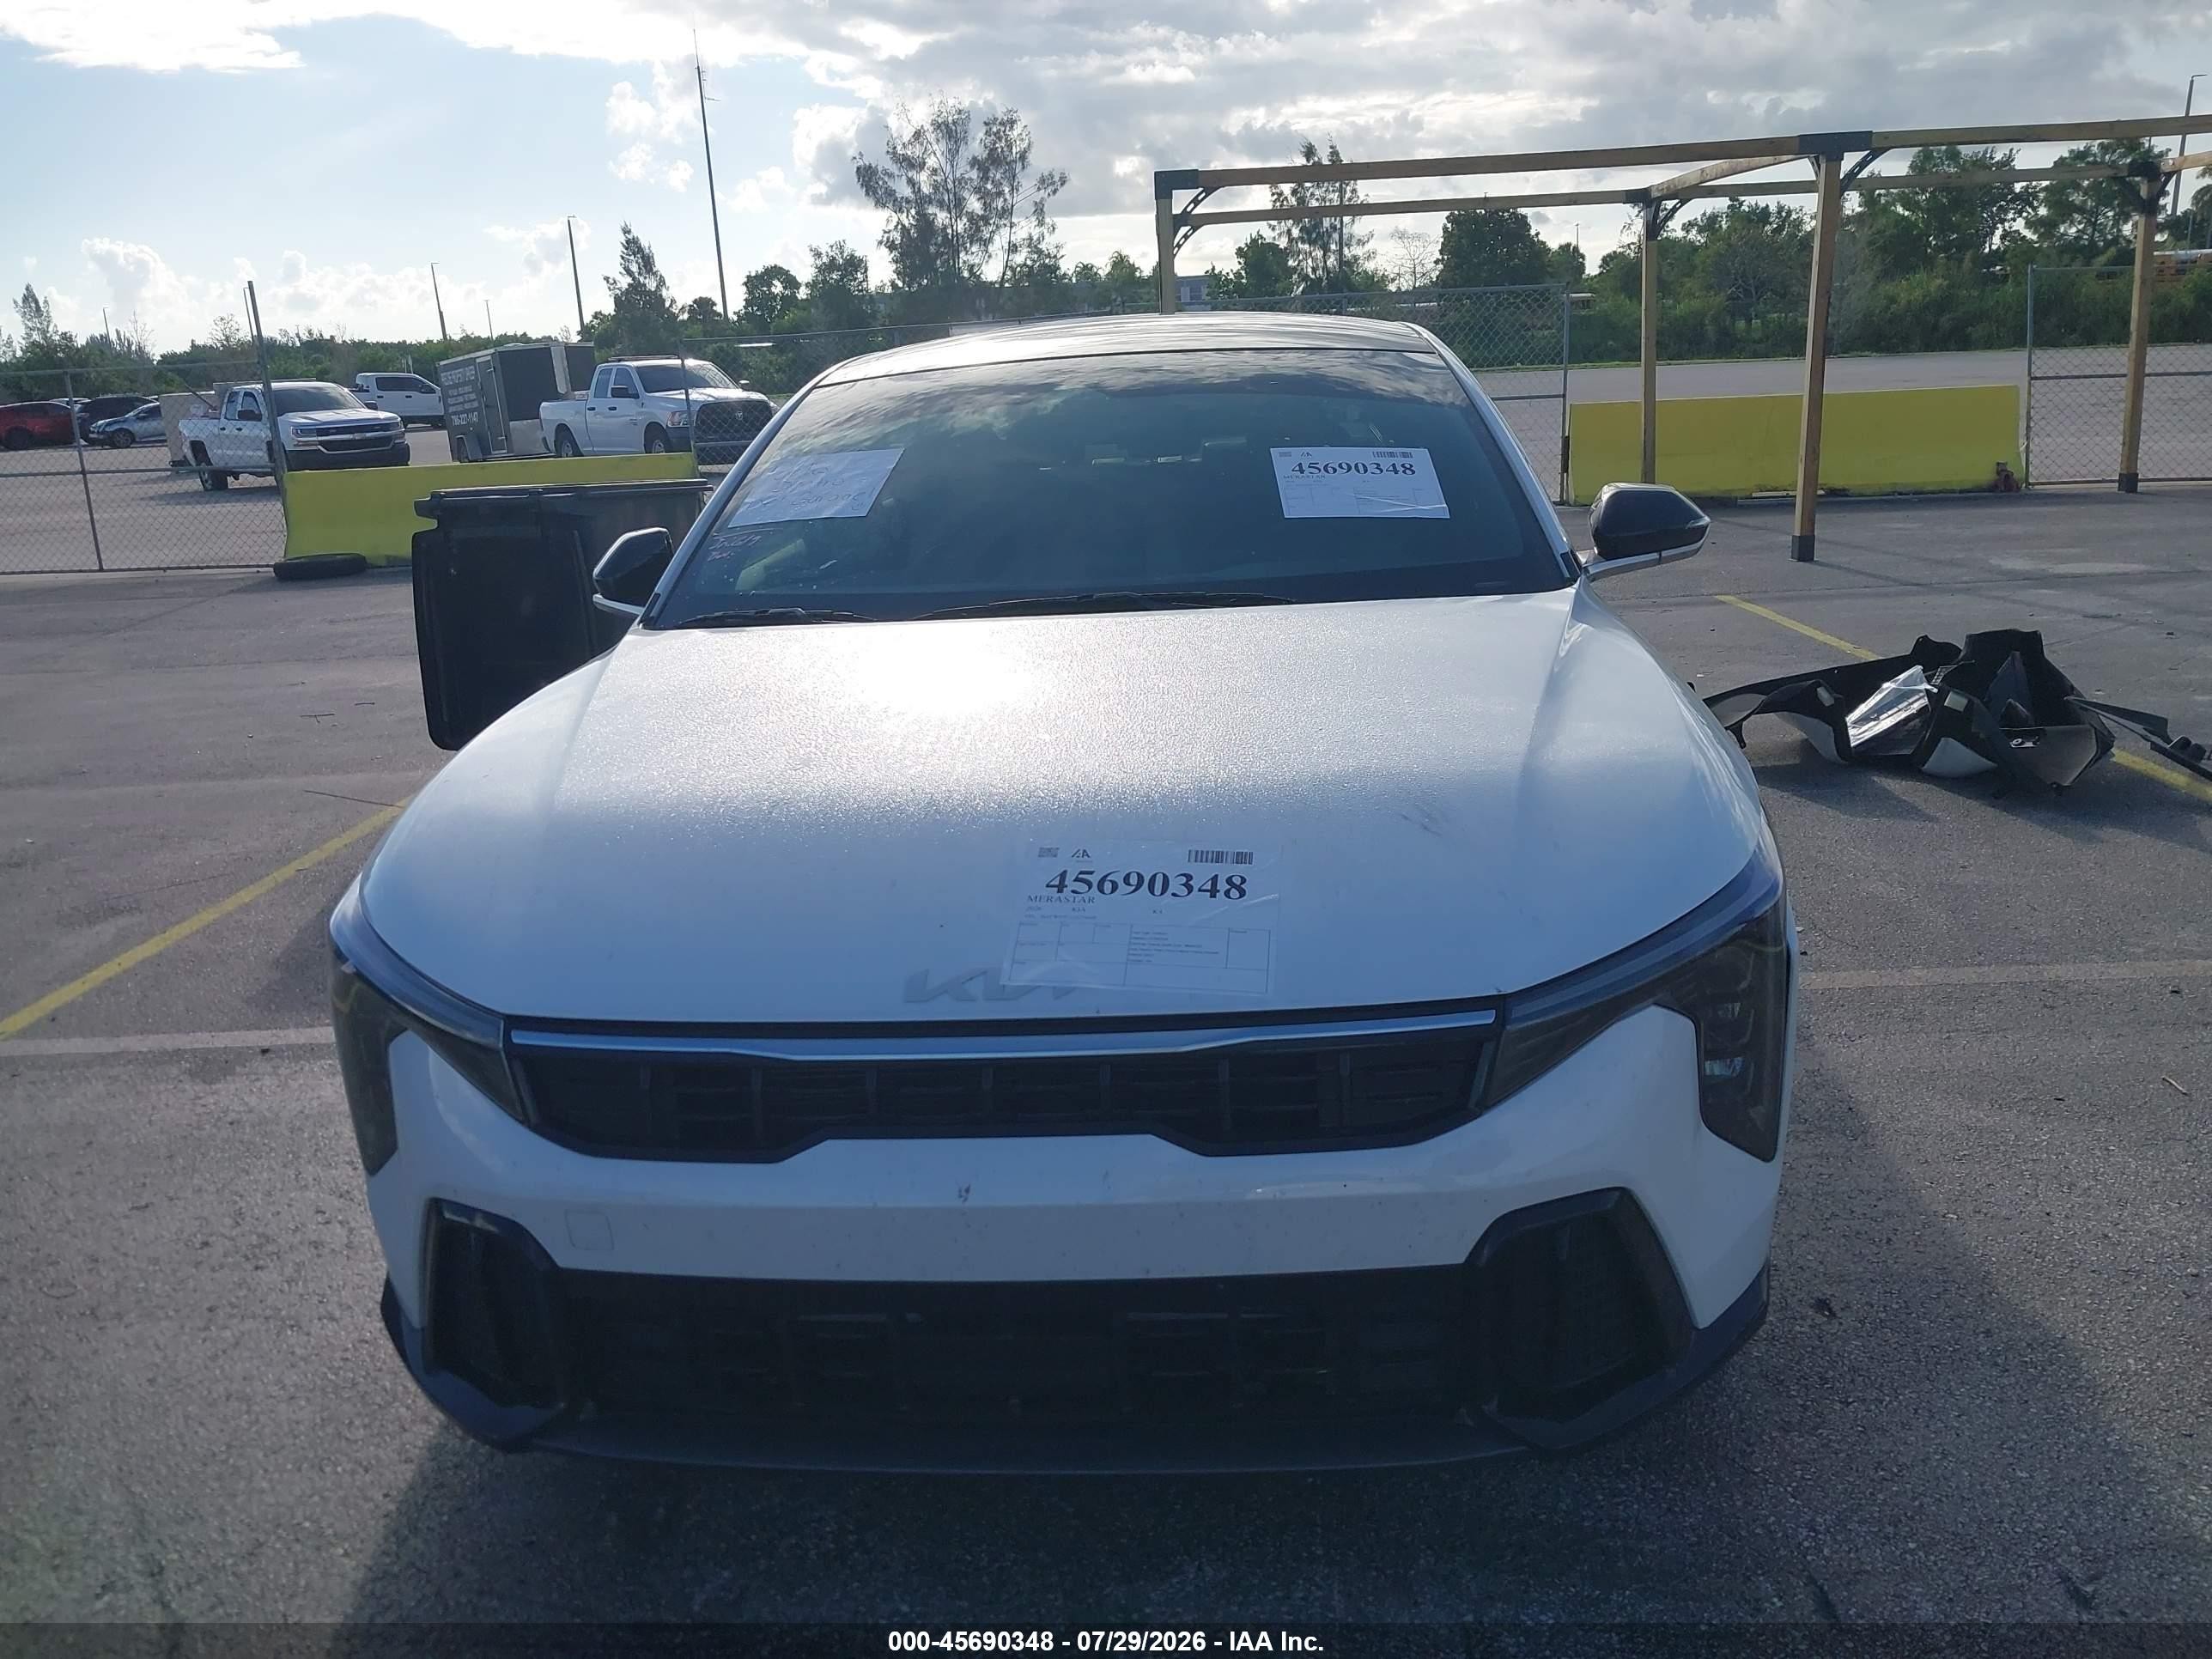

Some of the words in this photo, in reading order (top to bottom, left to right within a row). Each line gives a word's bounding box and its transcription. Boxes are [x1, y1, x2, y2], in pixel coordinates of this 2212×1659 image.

[1291, 461, 1416, 476] 45690348
[1045, 869, 1248, 901] 45690348
[1027, 895, 1096, 904] MERASTAR
